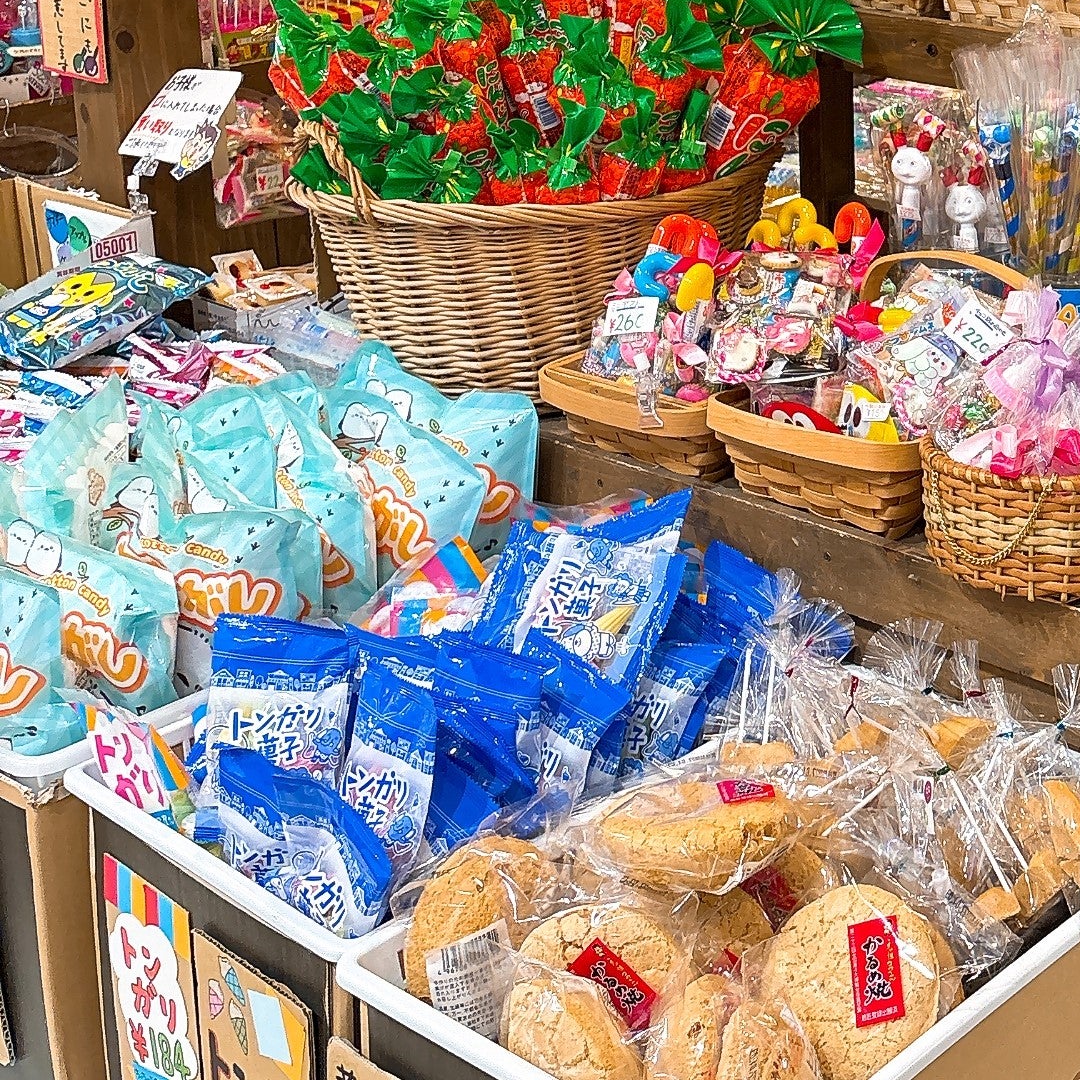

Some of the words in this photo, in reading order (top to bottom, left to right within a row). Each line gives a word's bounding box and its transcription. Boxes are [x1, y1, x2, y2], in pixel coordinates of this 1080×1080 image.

[95, 235, 135, 259] 05001
[185, 541, 230, 565] candy
[77, 583, 111, 617] candy
[563, 575, 604, 621] 菓子
[229, 706, 324, 743] トンガリ
[257, 735, 302, 767] 菓子
[340, 761, 410, 811] トンガリ
[121, 926, 161, 980] トン
[132, 977, 177, 1034] ガリ
[128, 1017, 191, 1080] ¥184
